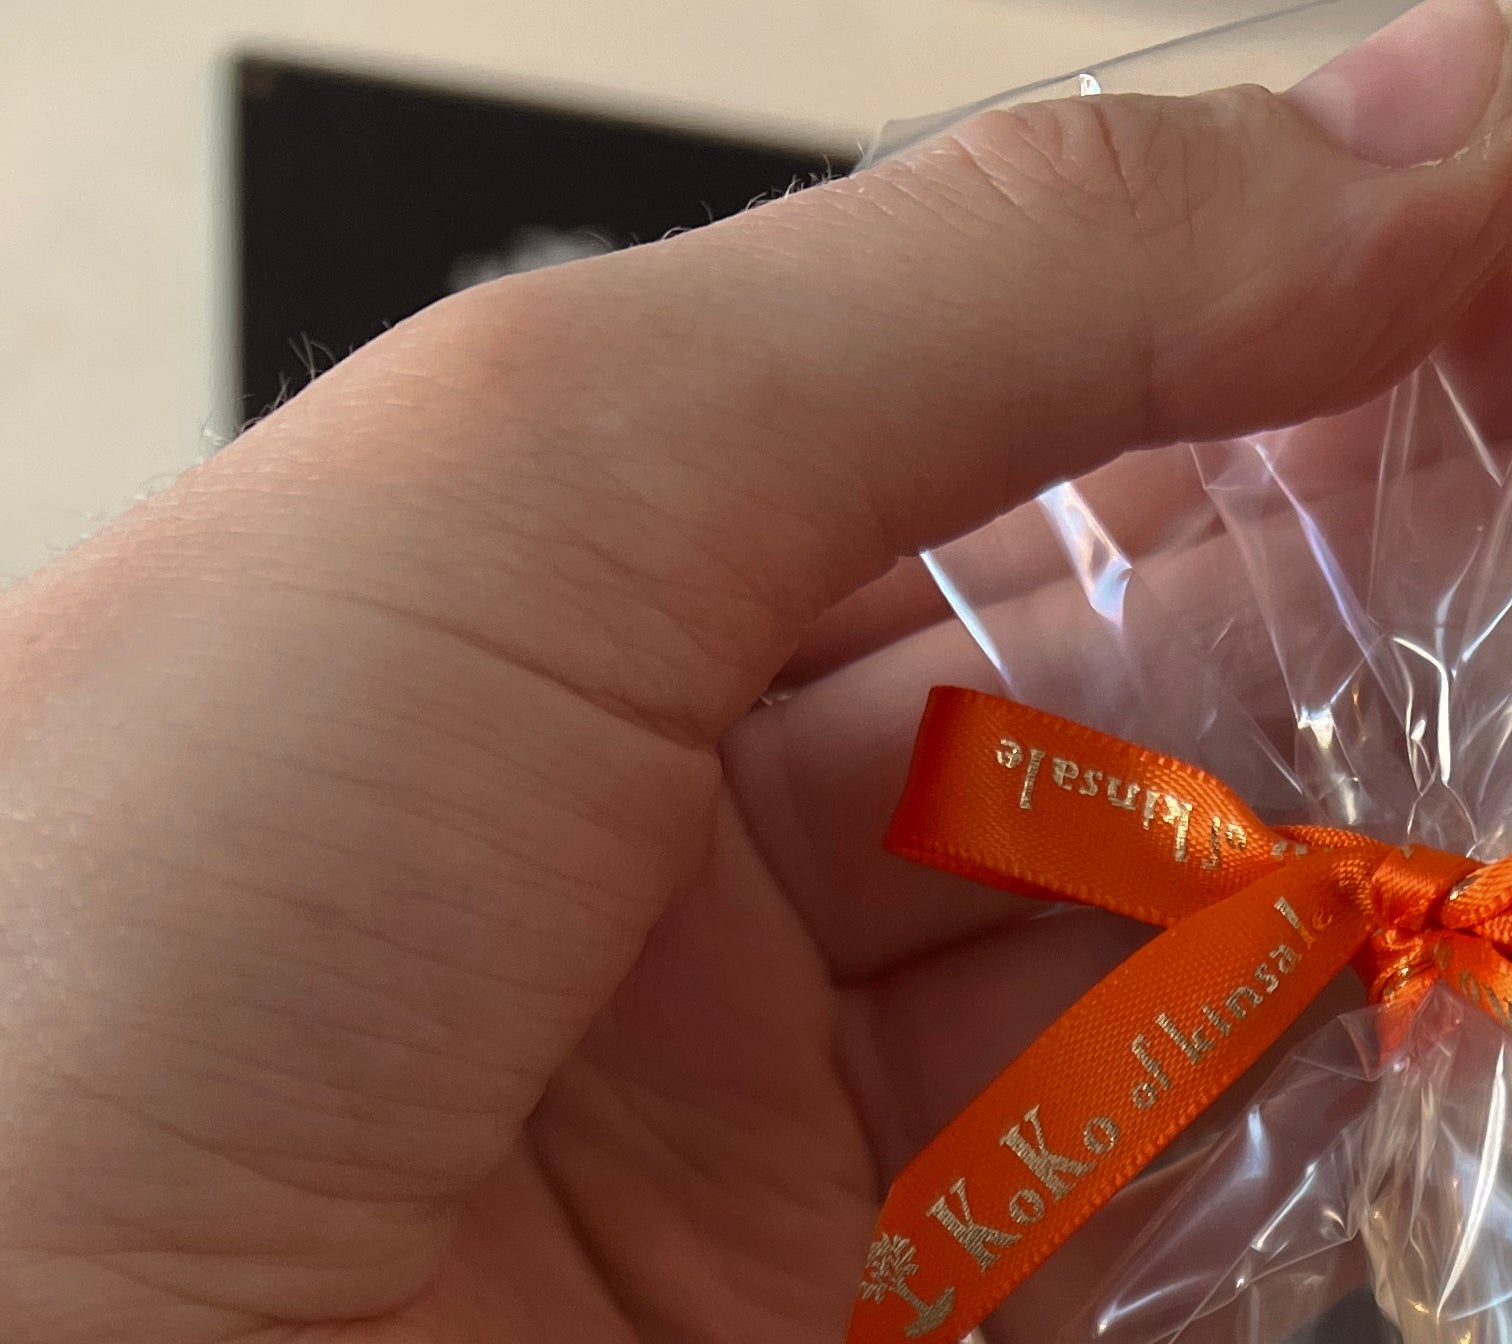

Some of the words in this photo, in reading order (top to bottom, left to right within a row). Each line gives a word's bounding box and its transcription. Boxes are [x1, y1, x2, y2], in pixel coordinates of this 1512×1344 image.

[996, 737, 1195, 863] kinsale
[926, 1105, 1121, 1274] KoKo
[1131, 1033, 1173, 1111] of
